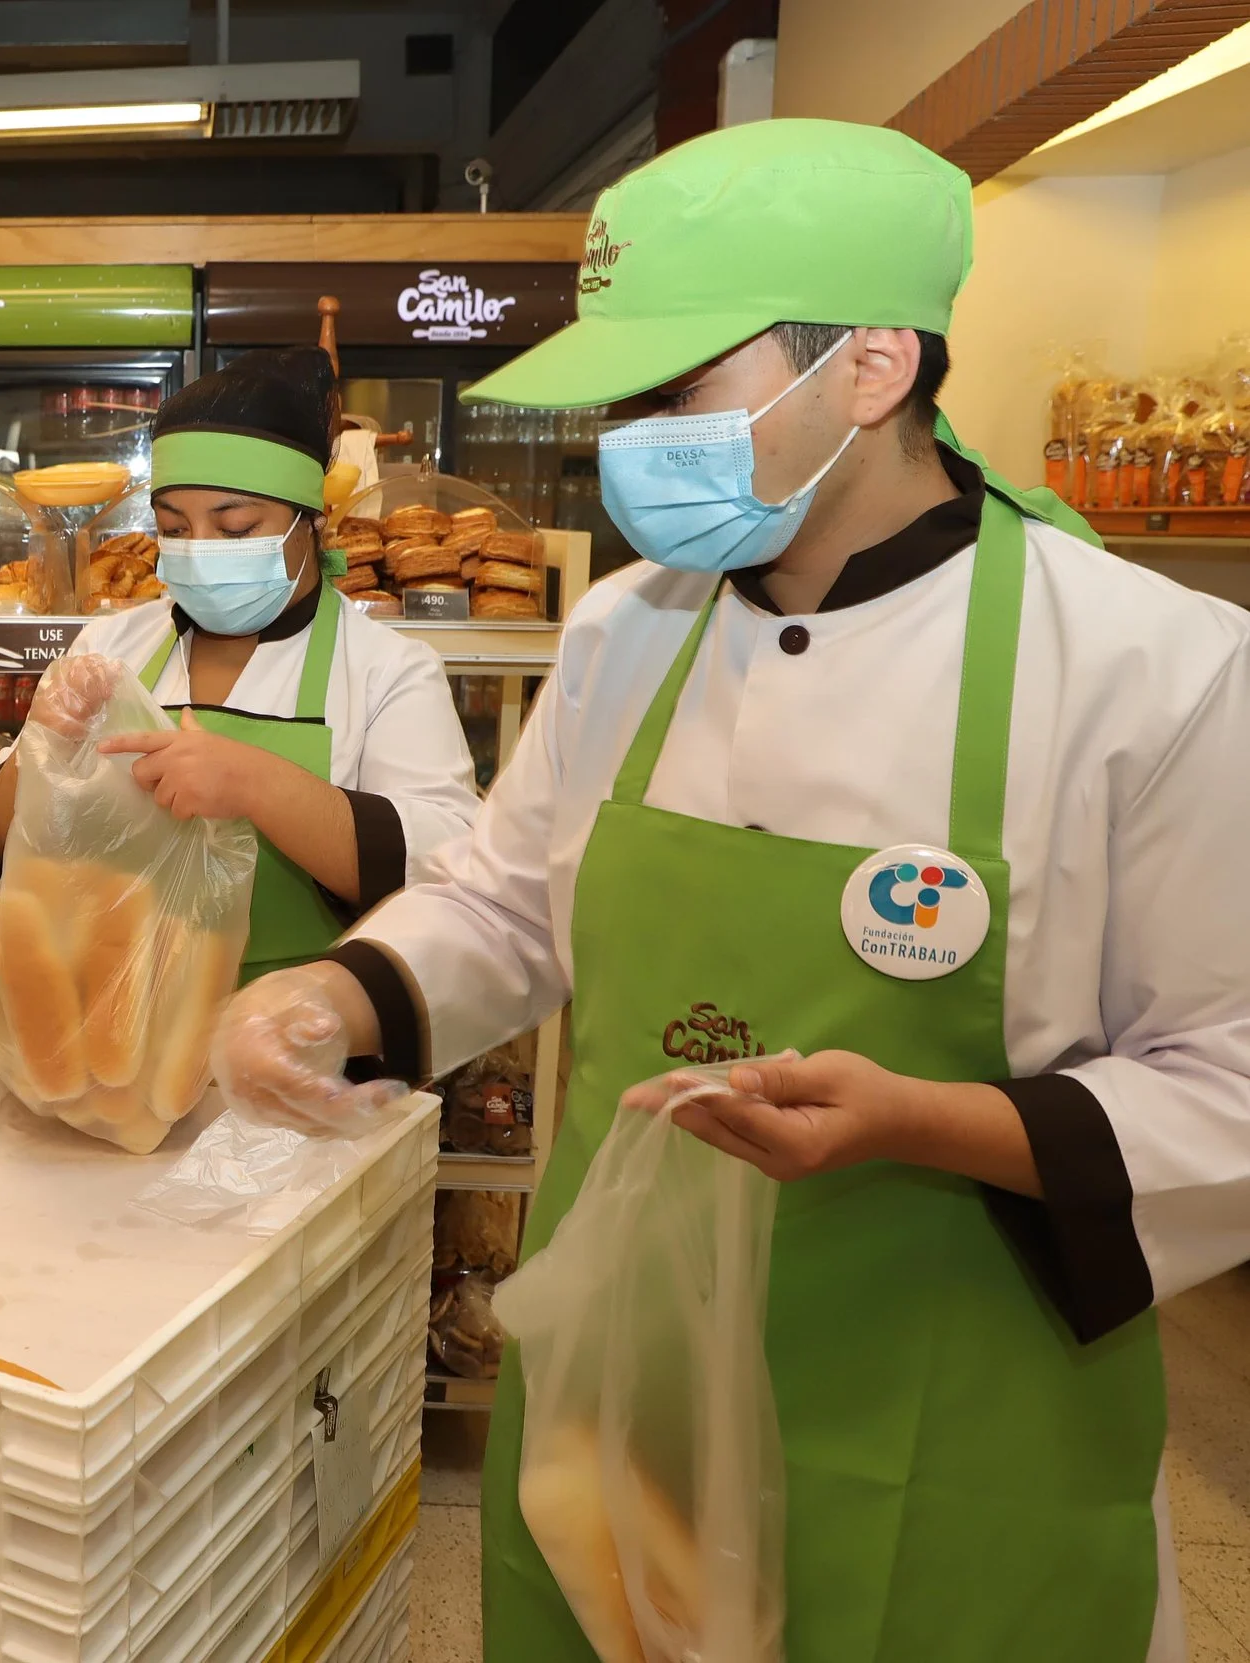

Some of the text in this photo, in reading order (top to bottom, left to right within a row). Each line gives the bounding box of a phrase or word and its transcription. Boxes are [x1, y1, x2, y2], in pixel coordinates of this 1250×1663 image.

[417, 268, 469, 298] San
[397, 287, 516, 326] Camilo
[667, 448, 707, 461] DEYSA
[675, 459, 701, 468] CARE
[39, 629, 63, 642] USE
[23, 647, 66, 660] TENAZ
[862, 926, 914, 942] Fundación
[861, 938, 957, 965] ConTRABAJO
[687, 1002, 752, 1042] San
